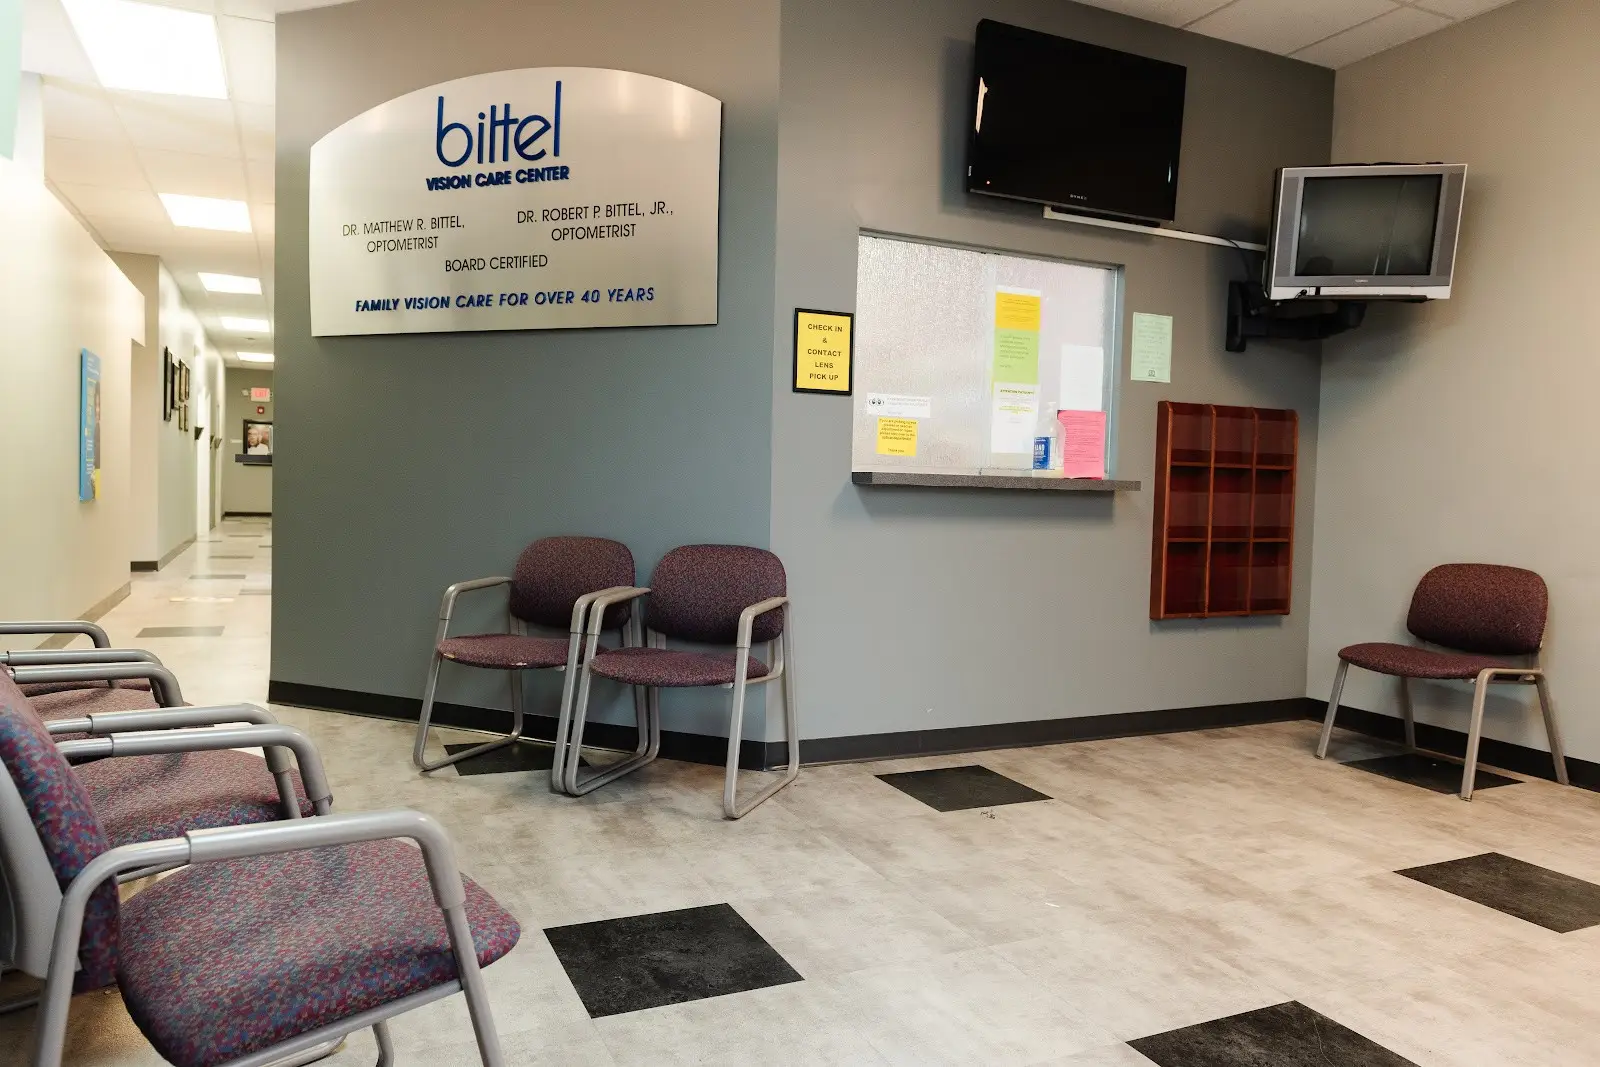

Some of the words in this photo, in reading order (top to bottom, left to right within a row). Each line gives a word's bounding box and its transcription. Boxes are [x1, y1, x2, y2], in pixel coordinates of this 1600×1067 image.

[436, 81, 563, 168] bittel
[426, 175, 471, 191] VISION
[475, 171, 512, 187] CARE
[515, 165, 570, 183] CENTER
[517, 210, 537, 224] DR.
[542, 206, 590, 222] ROBERT
[593, 205, 601, 218] P.
[605, 202, 645, 218] BITTEL,
[650, 201, 673, 216] JR.,
[342, 223, 360, 237] DR.
[363, 218, 414, 235] MATTHEW
[417, 217, 427, 231] R.
[430, 215, 465, 230] BITTEL,
[551, 223, 636, 242] OPTOMETRIST
[367, 236, 438, 253] OPTOMETRIST
[445, 258, 486, 272] BOARD
[489, 254, 548, 270] CERTIFIED
[355, 298, 399, 312] FAMILY
[403, 296, 450, 310] VISION
[455, 294, 493, 308] CARE
[499, 292, 528, 306] FOR
[534, 291, 574, 305] OVER
[580, 290, 600, 303] 40
[607, 287, 655, 302] YEARS
[807, 323, 833, 332] CHECK
[807, 348, 842, 357] CONTACT
[814, 361, 834, 369] LENS
